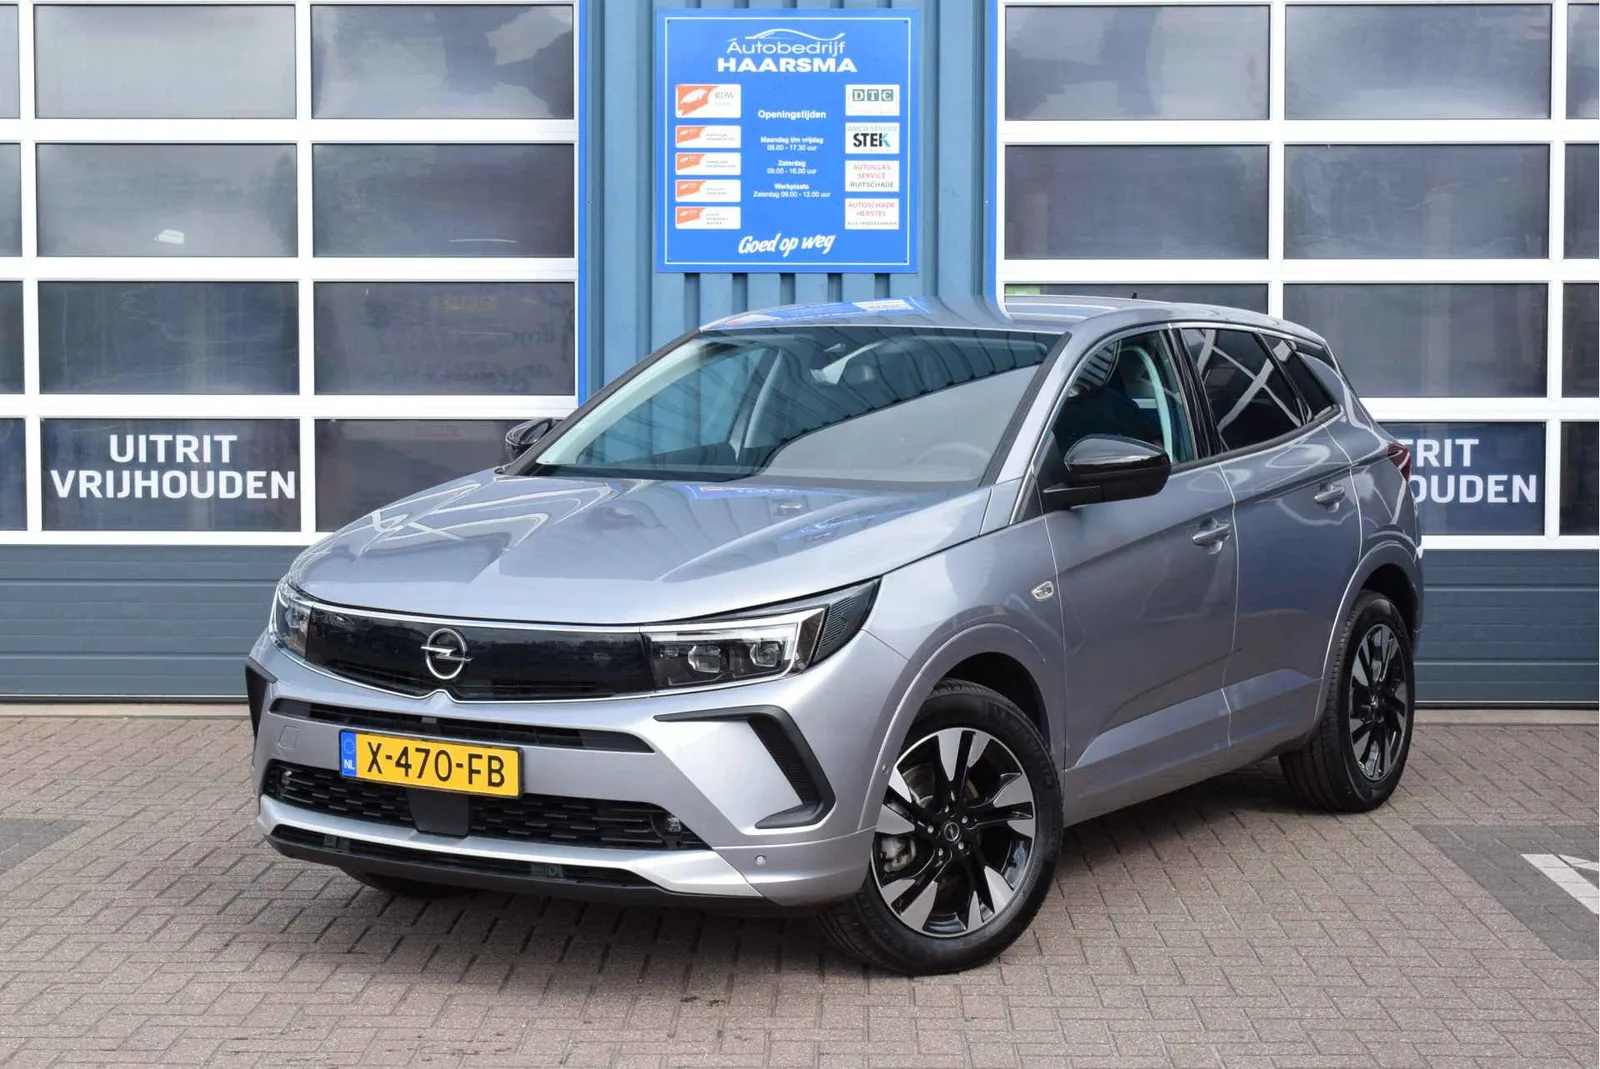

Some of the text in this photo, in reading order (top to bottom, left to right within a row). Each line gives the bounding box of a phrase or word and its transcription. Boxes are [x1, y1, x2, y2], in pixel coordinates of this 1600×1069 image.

[727, 41, 845, 57] Autobedrijf
[717, 57, 858, 72] HAARSMA
[852, 89, 893, 101] DTC
[758, 110, 826, 120] Openingstijden
[853, 133, 890, 147] STEK
[738, 233, 836, 257] Goed op weg
[110, 434, 237, 463] UITRIT
[50, 470, 295, 499] VRIJHOUDEN
[344, 759, 355, 770] NL
[367, 742, 505, 787] X-470-FB
